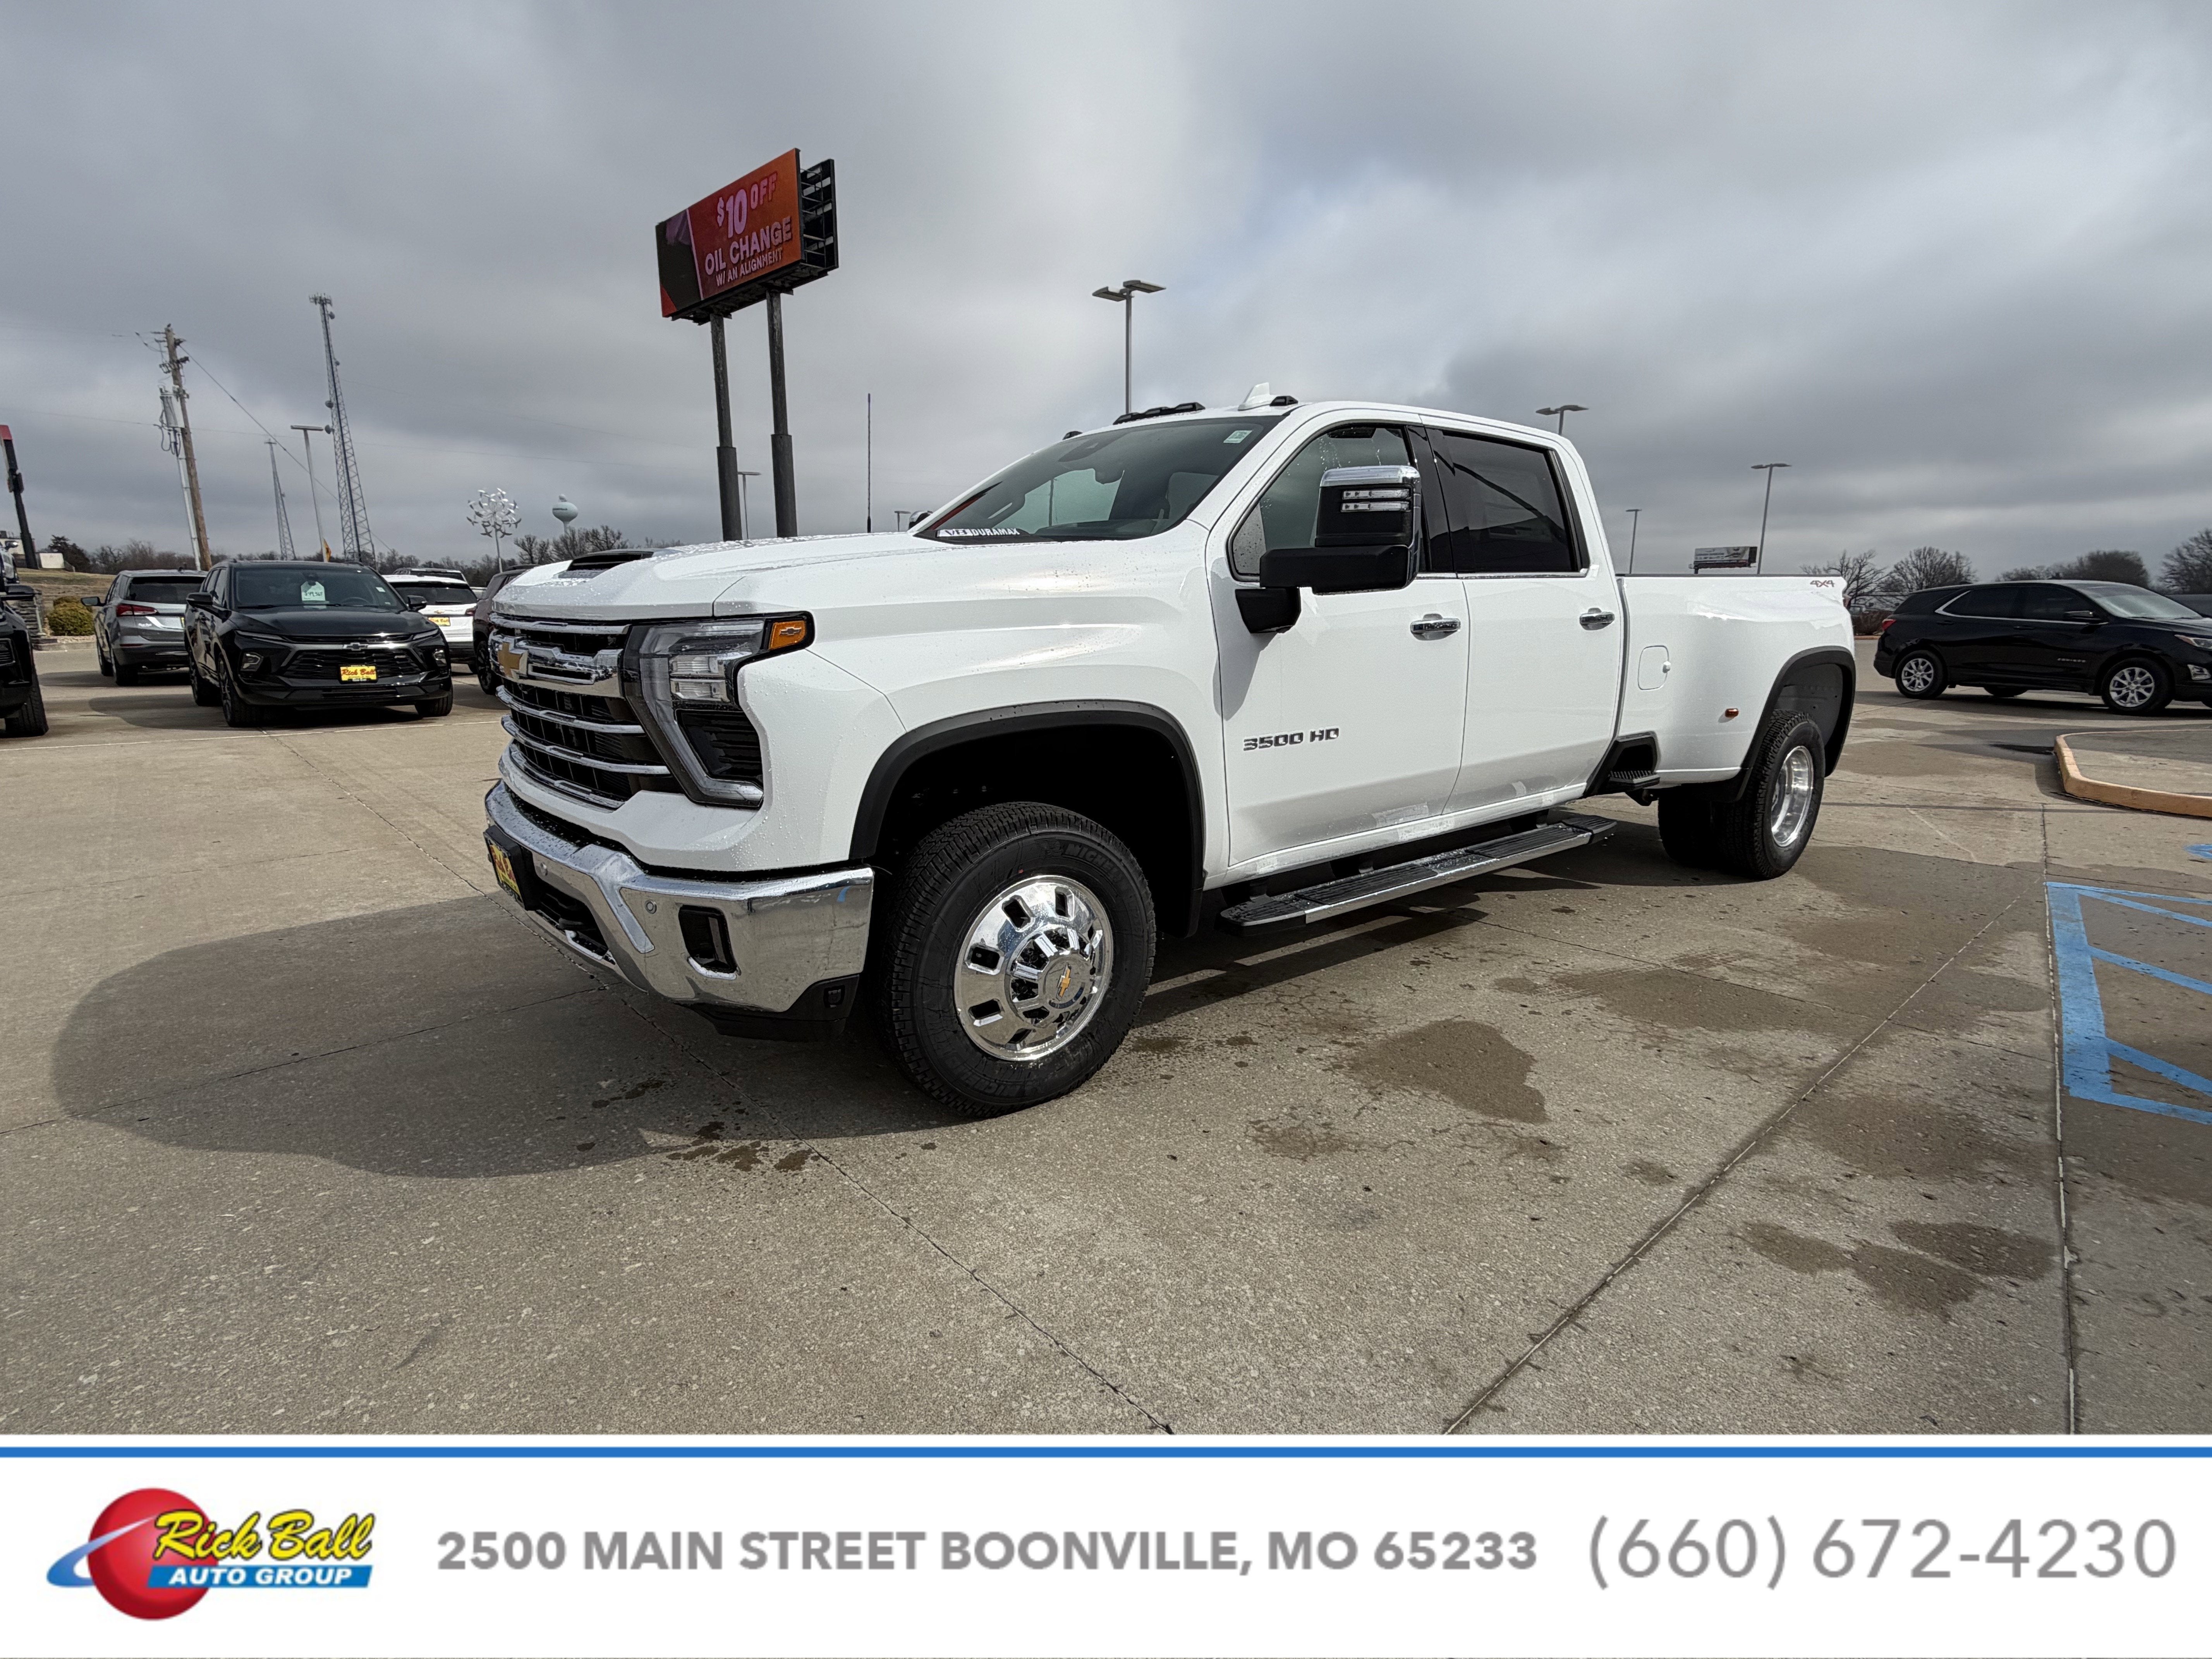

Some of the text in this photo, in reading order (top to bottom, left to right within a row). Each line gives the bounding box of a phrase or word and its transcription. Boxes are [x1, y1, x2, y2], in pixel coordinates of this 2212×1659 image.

[717, 173, 777, 238] $10 OFF
[705, 216, 792, 275] OIL CHANGE
[716, 247, 783, 286] W/ AN ALIGNMENT
[970, 528, 1020, 536] DURAMAX
[1243, 728, 1339, 751] 3500 HD
